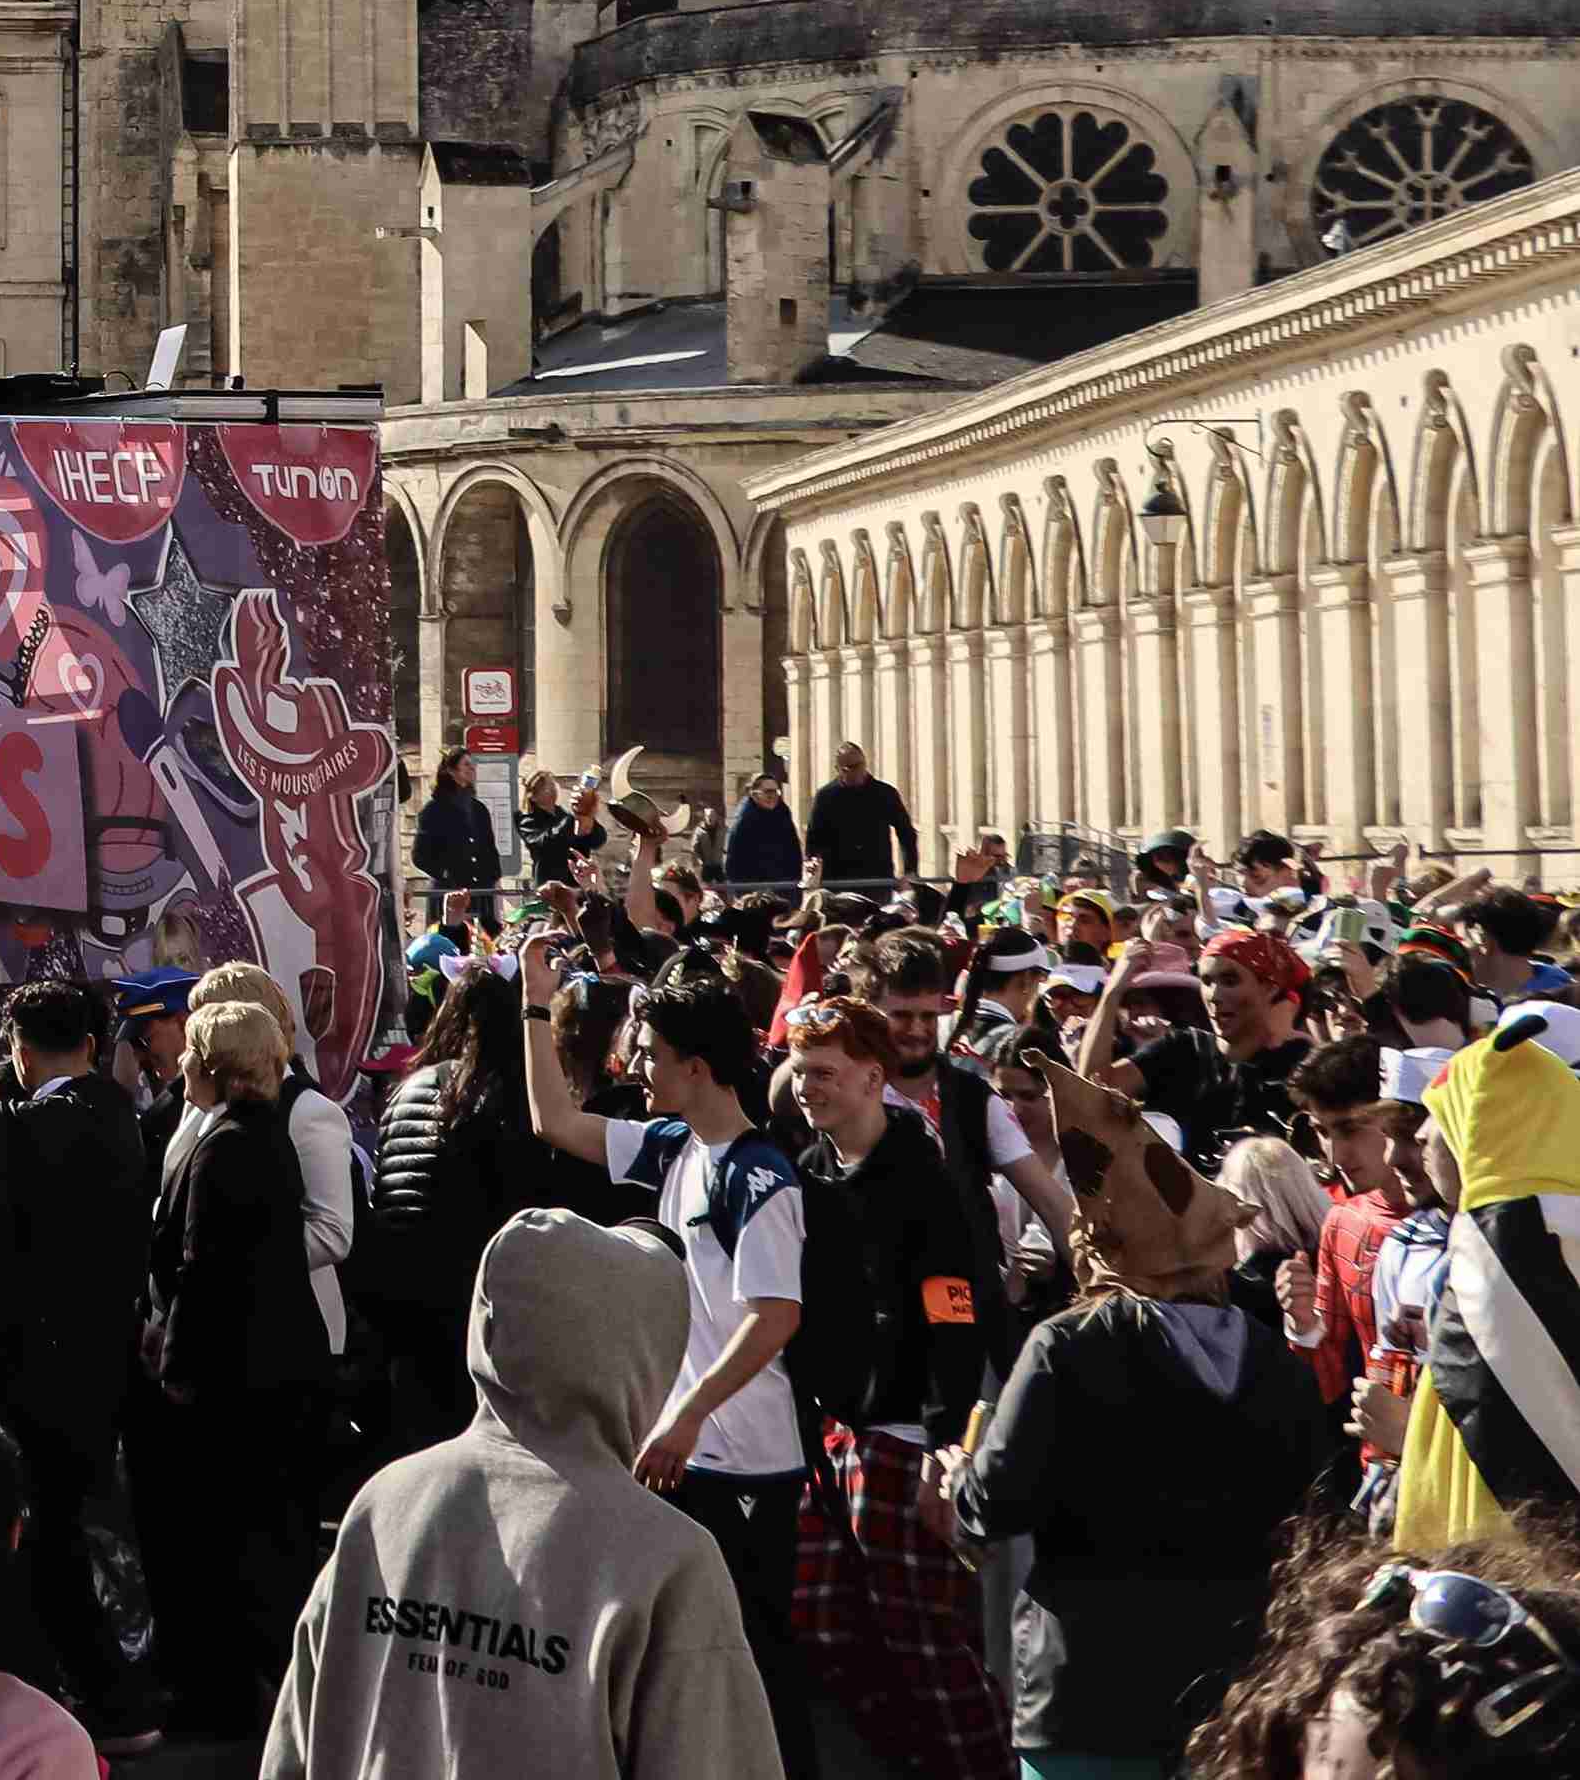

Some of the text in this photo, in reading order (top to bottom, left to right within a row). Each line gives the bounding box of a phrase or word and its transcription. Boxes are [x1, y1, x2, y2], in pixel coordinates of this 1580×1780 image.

[52, 449, 161, 503] IHECF
[238, 744, 258, 777] LES
[259, 765, 270, 786] 5
[365, 1595, 571, 1676] ESSENTIALS
[444, 1658, 471, 1680] OF
